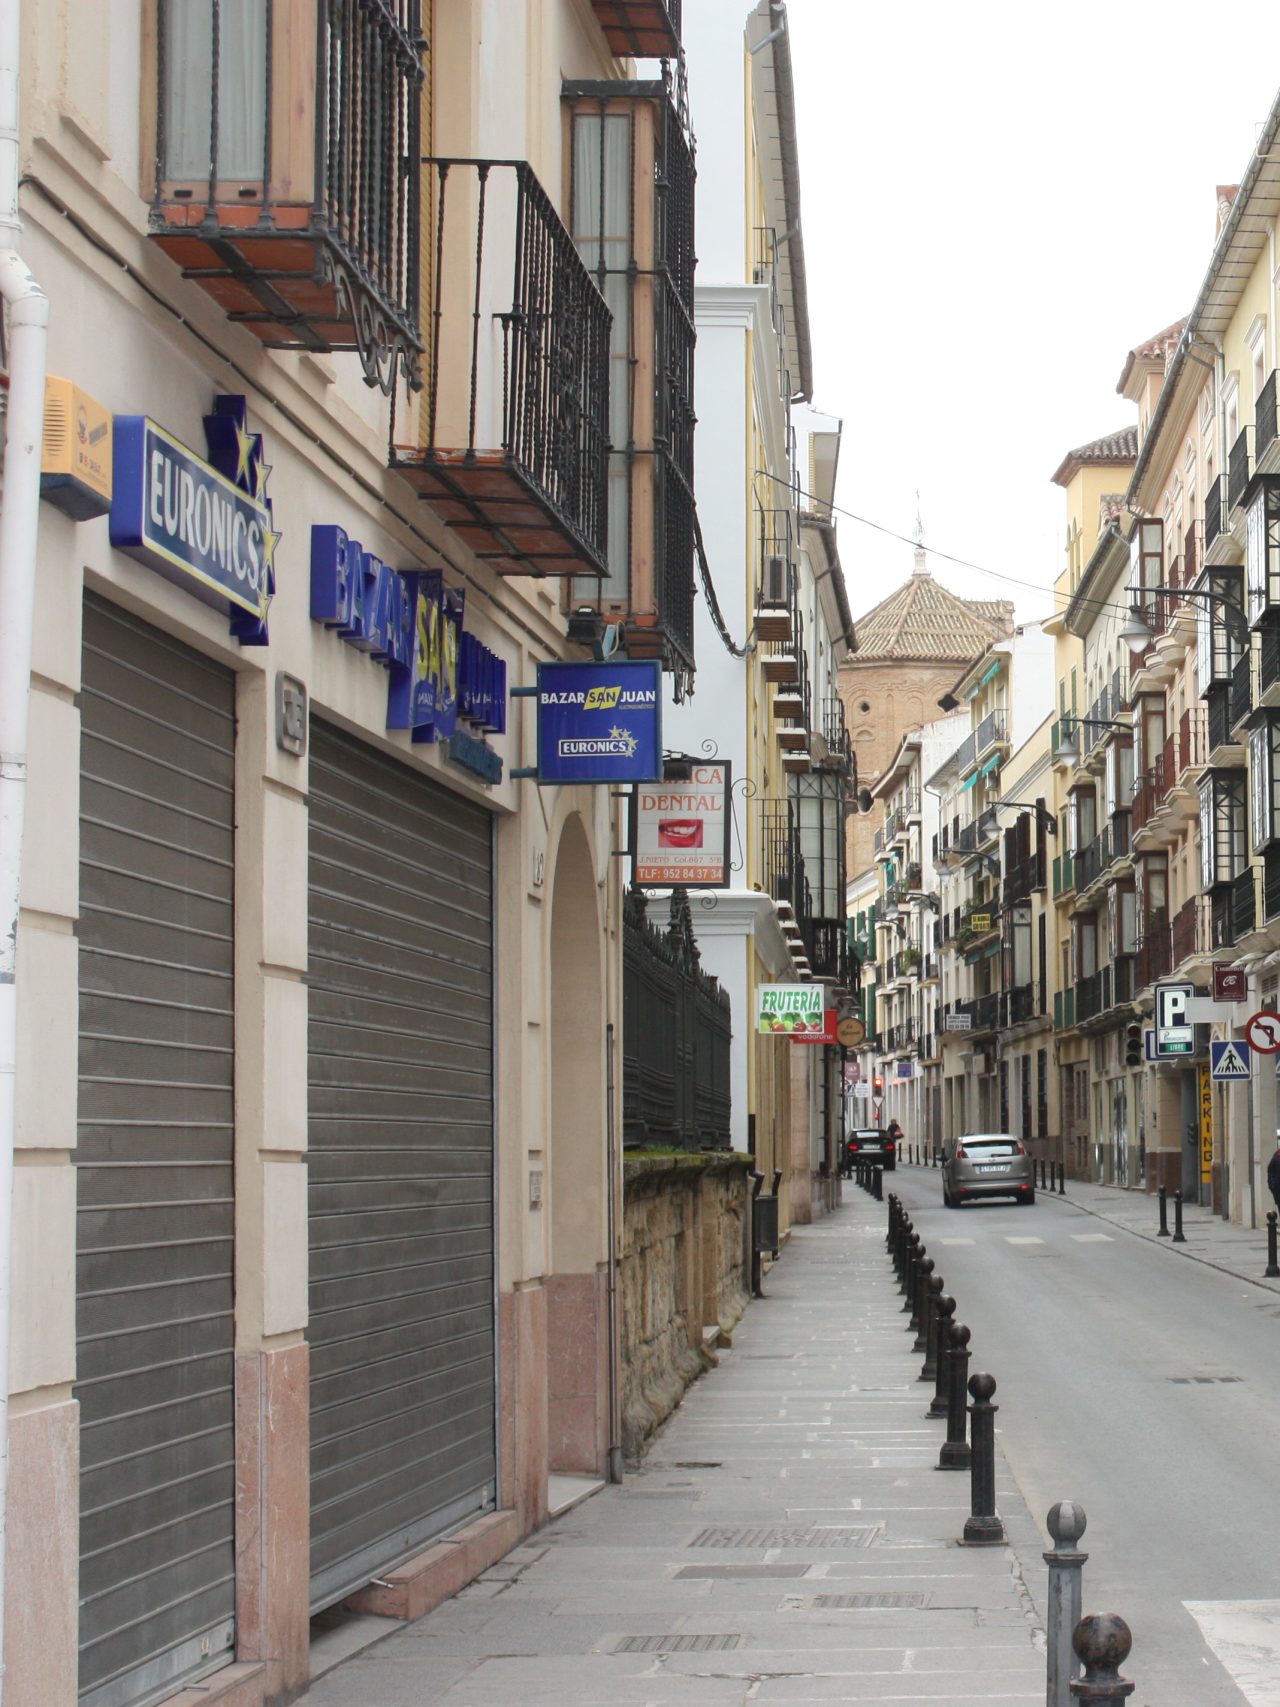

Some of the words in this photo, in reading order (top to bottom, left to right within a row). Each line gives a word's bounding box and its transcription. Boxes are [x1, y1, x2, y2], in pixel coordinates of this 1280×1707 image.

[149, 448, 261, 592] EURONICS
[541, 692, 585, 704] BAZAR
[589, 691, 616, 703] SAN
[620, 690, 656, 703] JUAN
[563, 741, 626, 753] EURONICS
[641, 795, 723, 811] DENTAL
[640, 868, 661, 879] TLF:
[663, 868, 681, 879] 952
[683, 868, 694, 879] 84
[697, 868, 708, 879] 37
[711, 868, 722, 879] 34
[762, 986, 820, 1012] FRUTERÍA
[1164, 991, 1187, 1027] P
[798, 1033, 833, 1041] vodafone
[1202, 1065, 1214, 1162] PARKING
